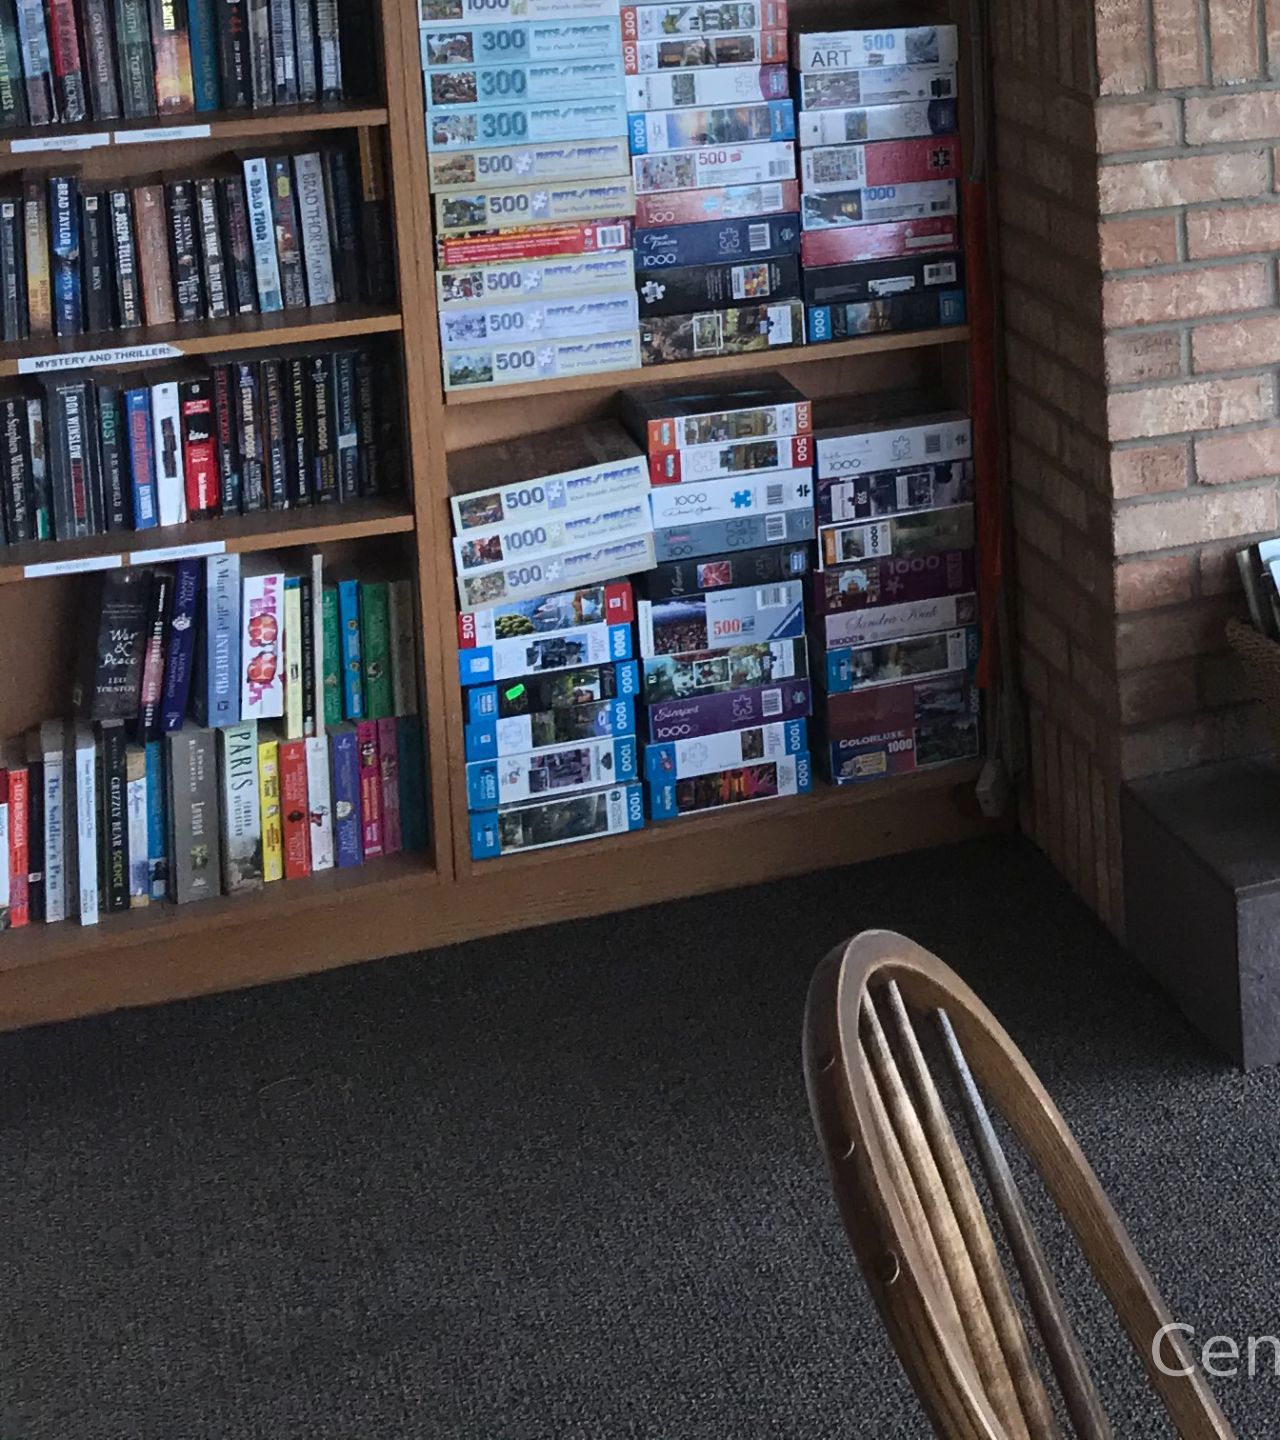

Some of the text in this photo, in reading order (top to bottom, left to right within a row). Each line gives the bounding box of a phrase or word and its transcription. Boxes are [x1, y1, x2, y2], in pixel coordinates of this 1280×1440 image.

[162, 6, 176, 31] SMITH
[624, 10, 636, 37] 300
[482, 29, 527, 52] 300
[862, 33, 896, 51] 500
[624, 44, 637, 72] 300
[811, 50, 852, 68] ART
[481, 69, 527, 97] 300
[483, 112, 528, 139] 300
[634, 118, 649, 150] 1000
[479, 155, 514, 174] 500
[698, 151, 728, 166] 500
[57, 183, 72, 247] BRAD TAYLOR
[490, 194, 530, 215] 500
[647, 211, 676, 224] 500
[643, 254, 677, 268] 1000
[487, 272, 521, 291] 500
[489, 313, 525, 333] 500
[813, 309, 826, 338] 1000
[34, 356, 84, 369] MYSTERY
[87, 352, 112, 363] AND
[495, 351, 536, 371] 500
[292, 361, 303, 398] STUART
[102, 402, 116, 446] FROST
[241, 387, 257, 459] STUART WOODS
[315, 383, 329, 452] STUART WOODS
[797, 404, 808, 429] 300
[8, 419, 24, 486] Stephen White
[796, 436, 807, 462] 500
[829, 459, 861, 472] 1000
[504, 486, 545, 510] 500
[674, 492, 708, 506] 1000
[503, 527, 548, 552] 1000
[216, 557, 230, 565] A
[886, 556, 941, 576] 1000
[217, 569, 230, 593] Man
[507, 565, 543, 588] 500
[110, 628, 139, 641] War
[461, 614, 475, 640] 500
[713, 617, 742, 636] 500
[115, 642, 133, 657] &
[612, 629, 626, 658] 1000
[100, 653, 138, 669] Peace
[215, 634, 230, 698] INTREPID
[108, 677, 127, 685] LEO
[620, 665, 633, 694] 1000
[614, 701, 627, 730] 1000
[656, 724, 691, 739] 1000
[789, 723, 801, 751] 1000
[620, 742, 632, 772] 1000
[887, 738, 914, 754] 1000
[228, 731, 254, 792] PARIS
[796, 758, 809, 787] 1000
[48, 777, 61, 800] The
[629, 792, 642, 821] 1000
[112, 821, 123, 848] BEAR
[50, 864, 61, 890] Pen
